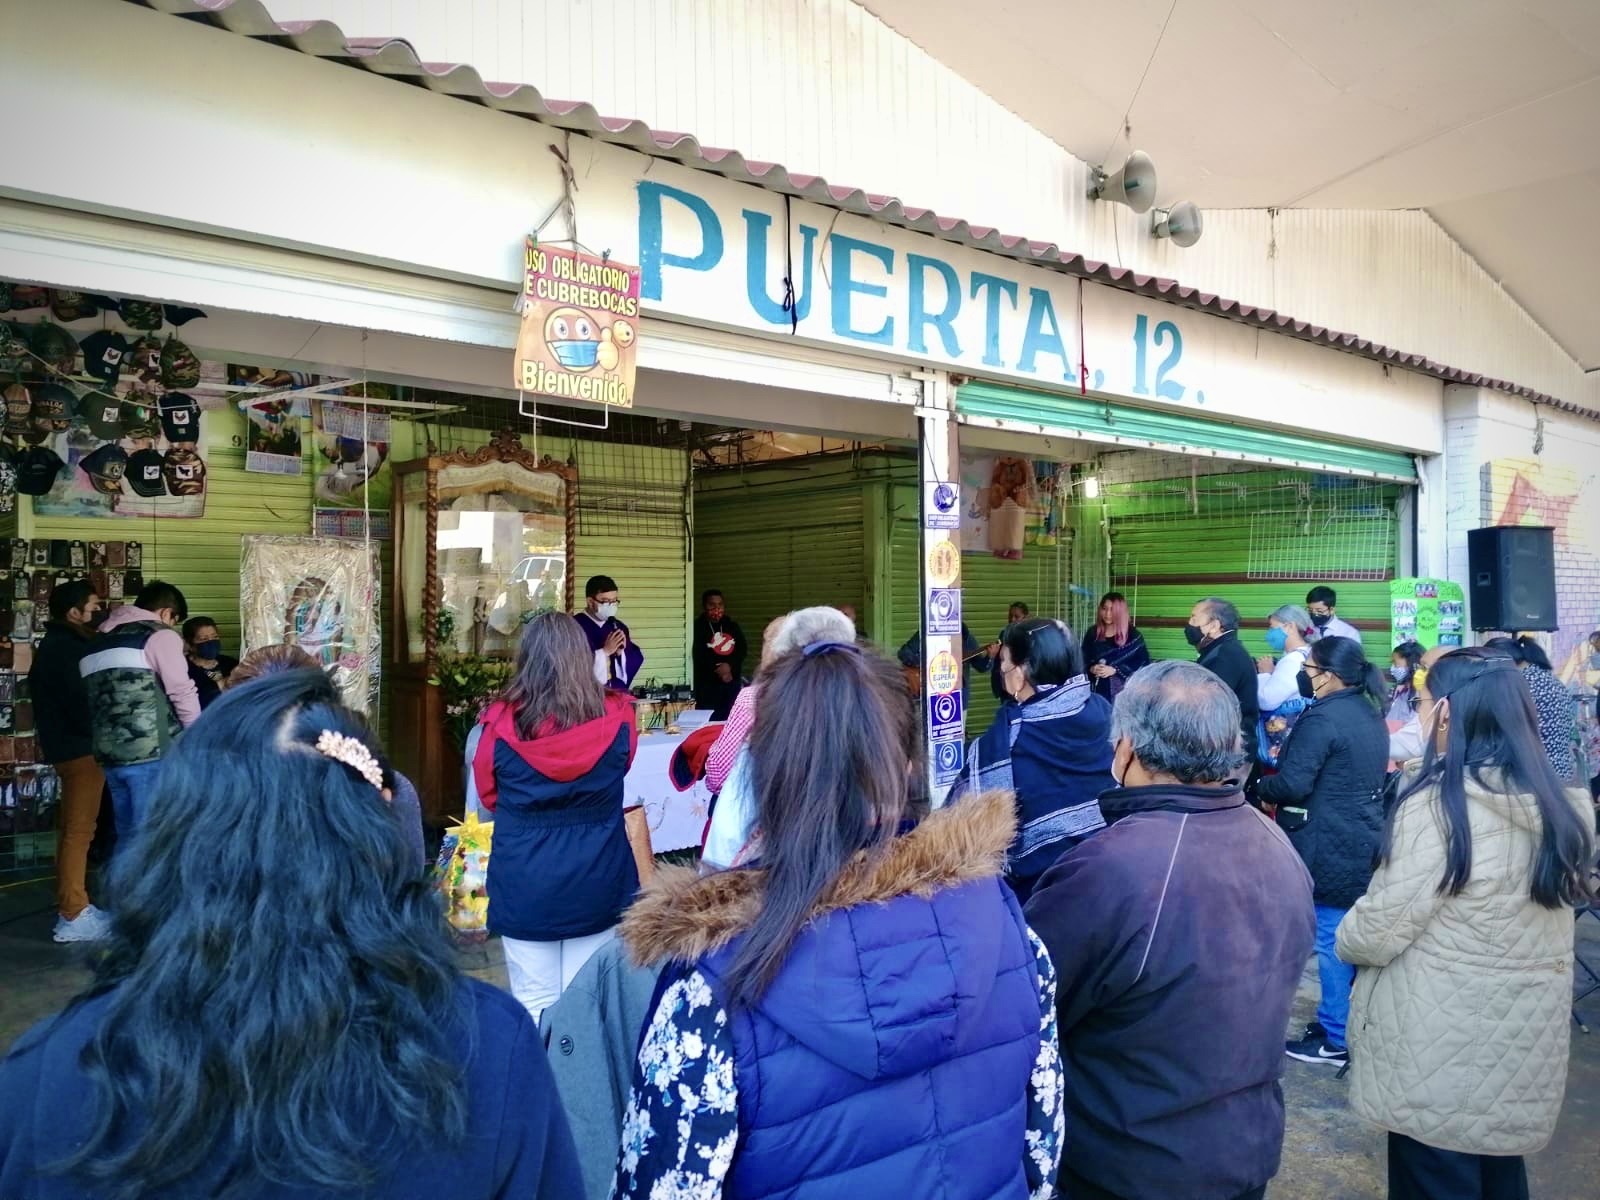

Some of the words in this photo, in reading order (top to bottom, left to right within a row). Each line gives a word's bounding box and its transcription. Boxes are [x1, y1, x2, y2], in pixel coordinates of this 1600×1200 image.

[525, 248, 547, 275] USO
[552, 255, 630, 294] OBLIGATORIO
[525, 273, 535, 296] E
[537, 278, 638, 317] CUBREBOCAS
[521, 359, 628, 406] Bienvenido
